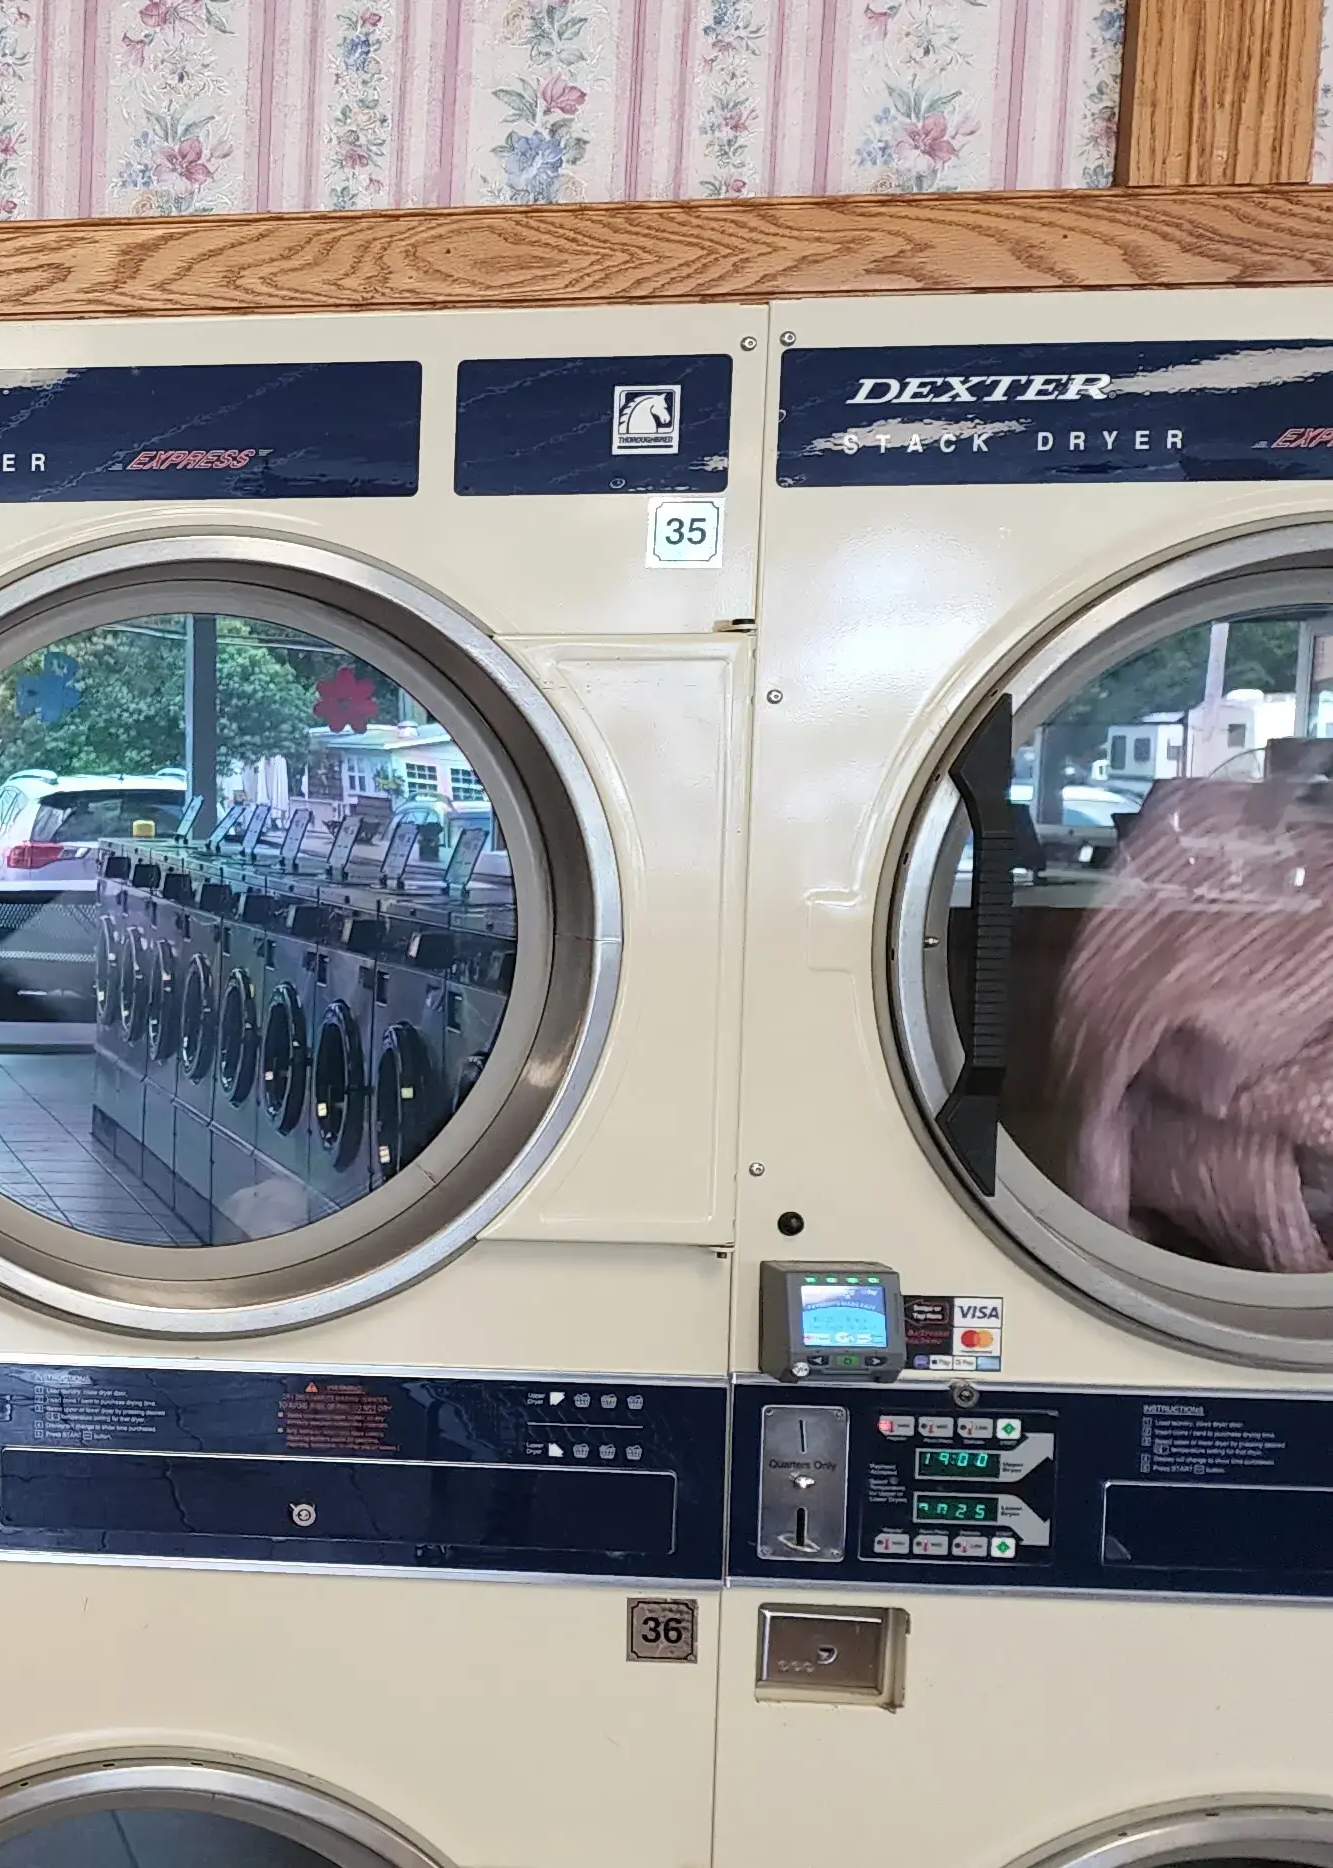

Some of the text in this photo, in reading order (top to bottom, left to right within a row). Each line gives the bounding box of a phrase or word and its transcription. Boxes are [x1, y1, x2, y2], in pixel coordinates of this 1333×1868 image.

[845, 373, 1112, 405] DEXTER
[842, 430, 1185, 456] STACK DRYER
[124, 449, 257, 471] EXPRESS
[665, 517, 707, 545] 35
[957, 1305, 1000, 1320] VISA
[769, 1460, 837, 1472] Quarters Only
[641, 1616, 683, 1644] 36
